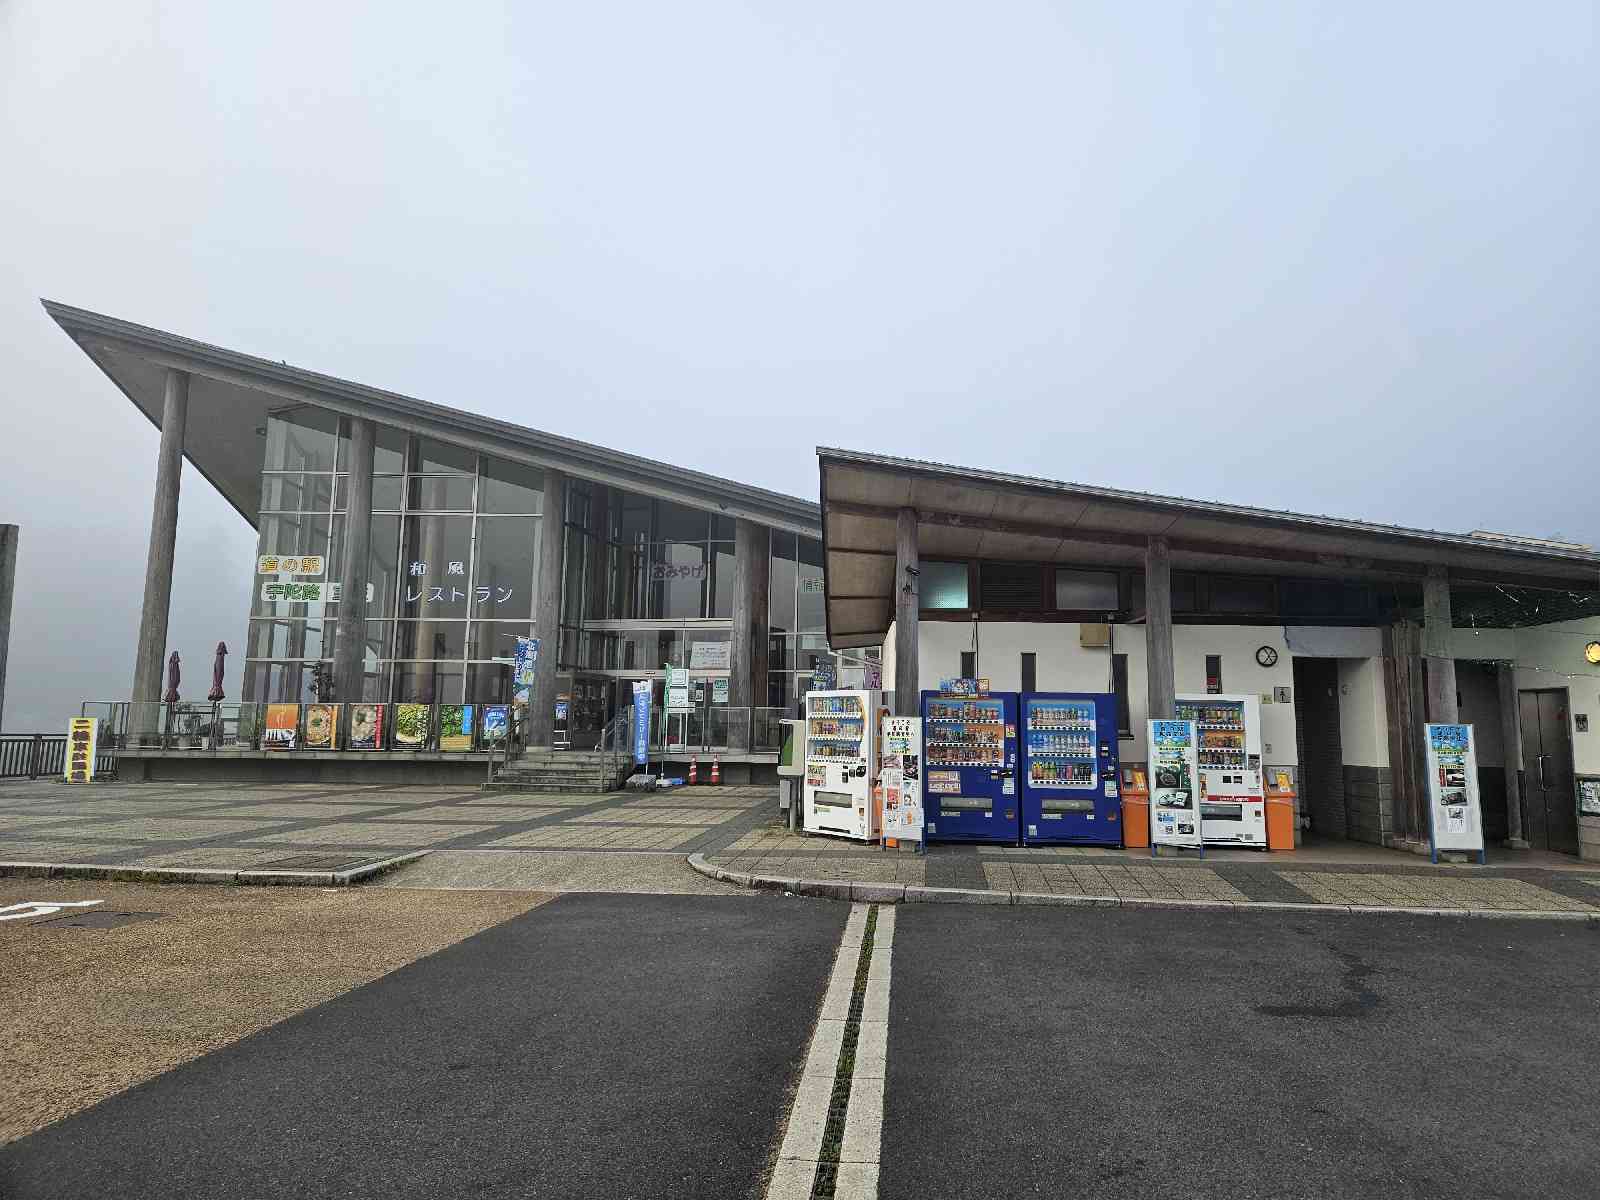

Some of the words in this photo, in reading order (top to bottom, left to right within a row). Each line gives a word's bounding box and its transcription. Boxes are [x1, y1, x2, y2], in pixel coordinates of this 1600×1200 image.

[409, 561, 465, 576] 和風
[265, 584, 341, 600] 宇陀路
[406, 585, 513, 602] レストラン
